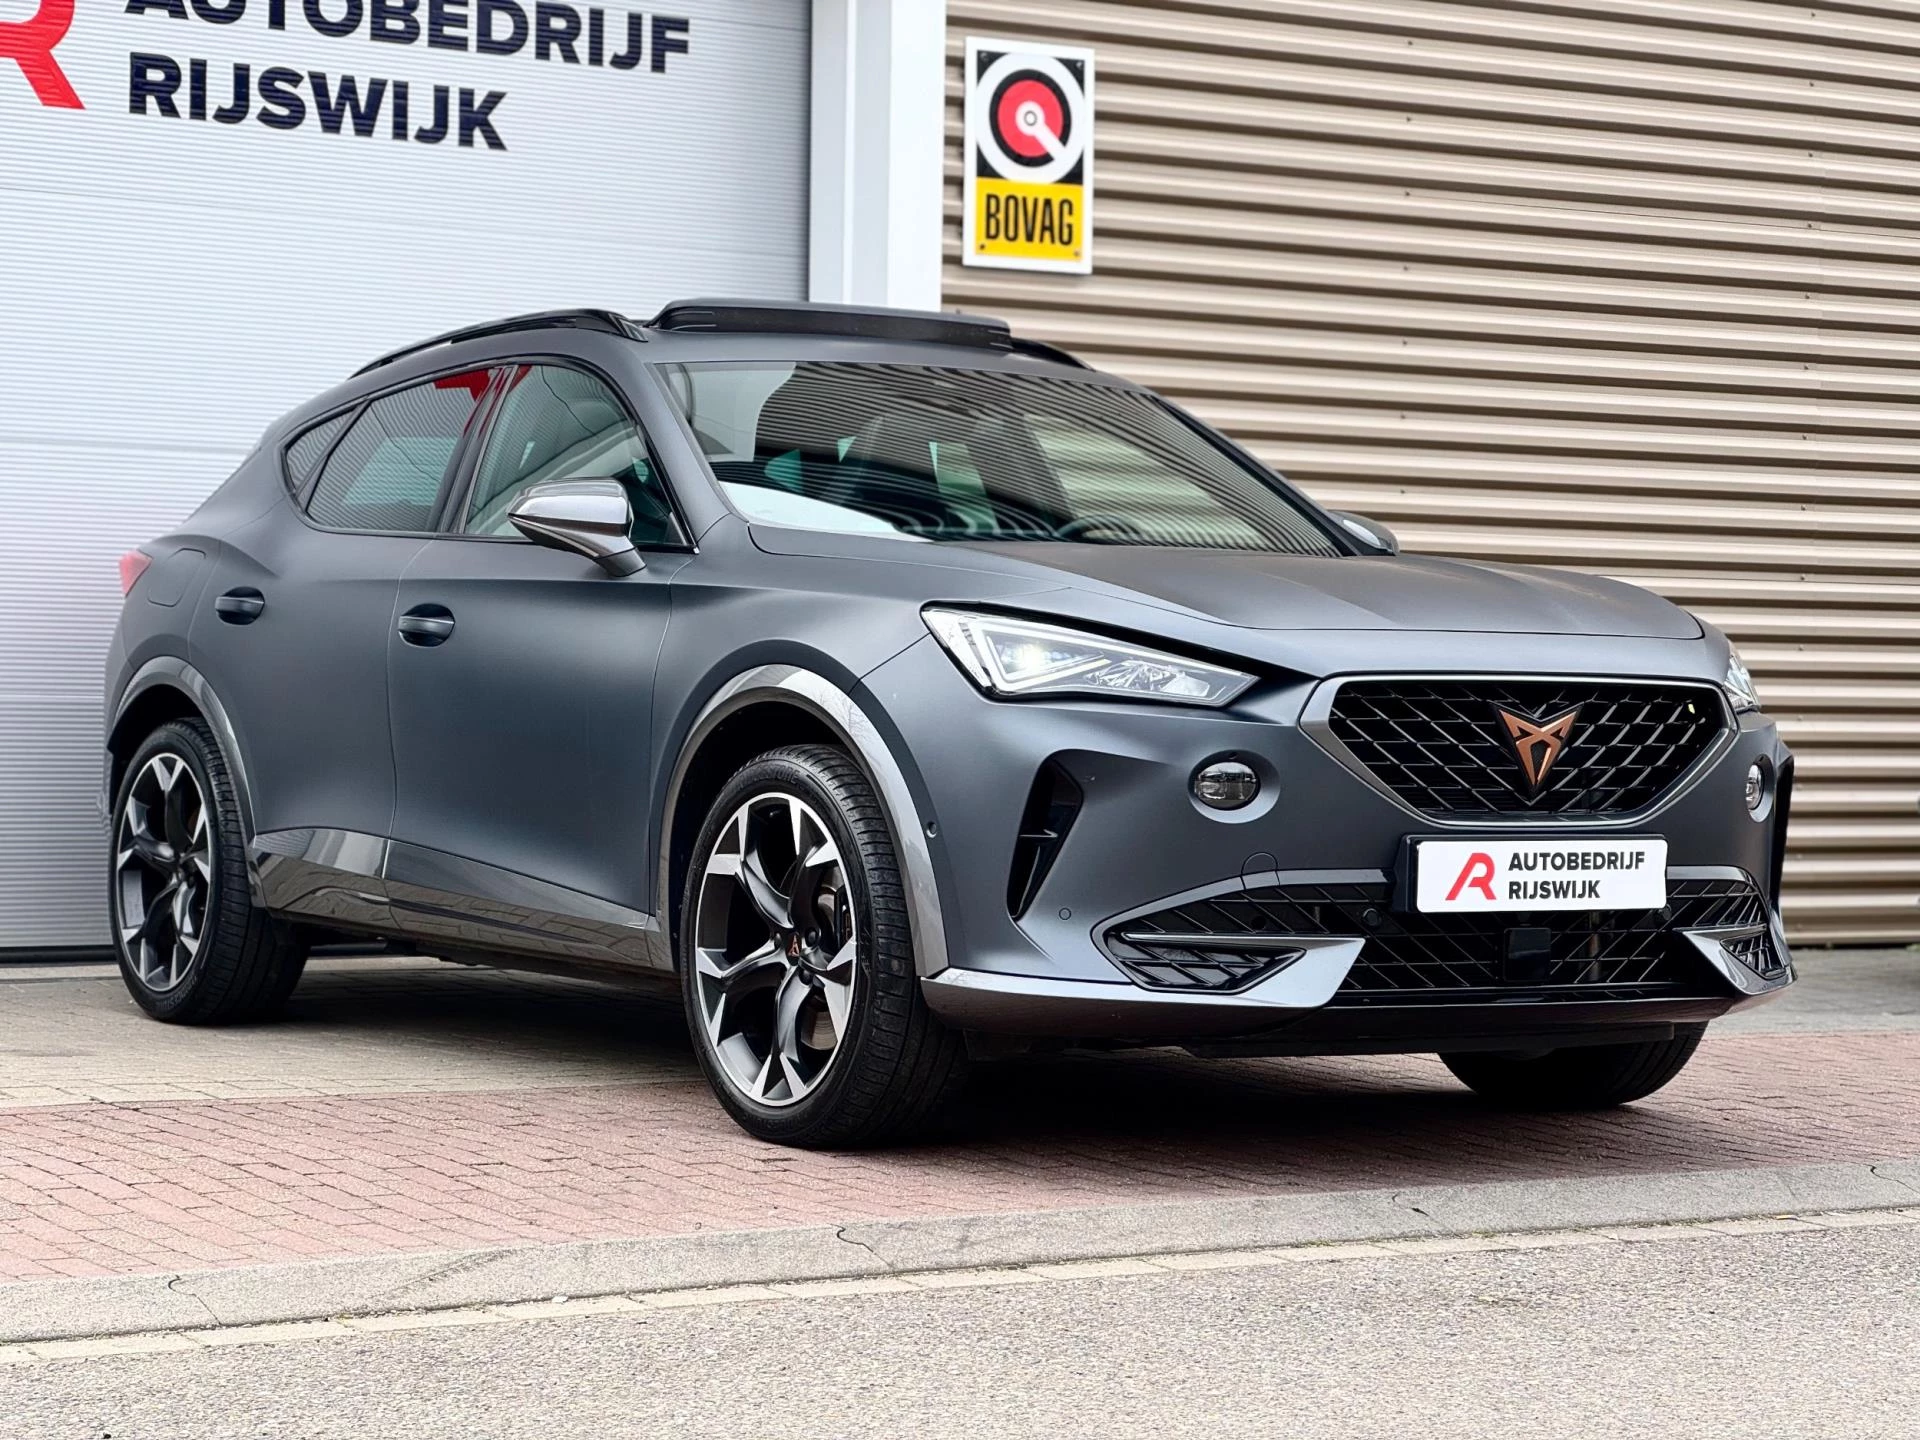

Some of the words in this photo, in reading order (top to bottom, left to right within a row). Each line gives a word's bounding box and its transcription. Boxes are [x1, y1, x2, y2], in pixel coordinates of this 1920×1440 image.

[125, 0, 689, 73] OBEDRIJF
[129, 52, 507, 151] RIJSWIJK
[985, 193, 1073, 246] BOVAG
[1508, 851, 1645, 871] AUTOBEDRIJF
[1508, 880, 1601, 899] RIJSWIJK
